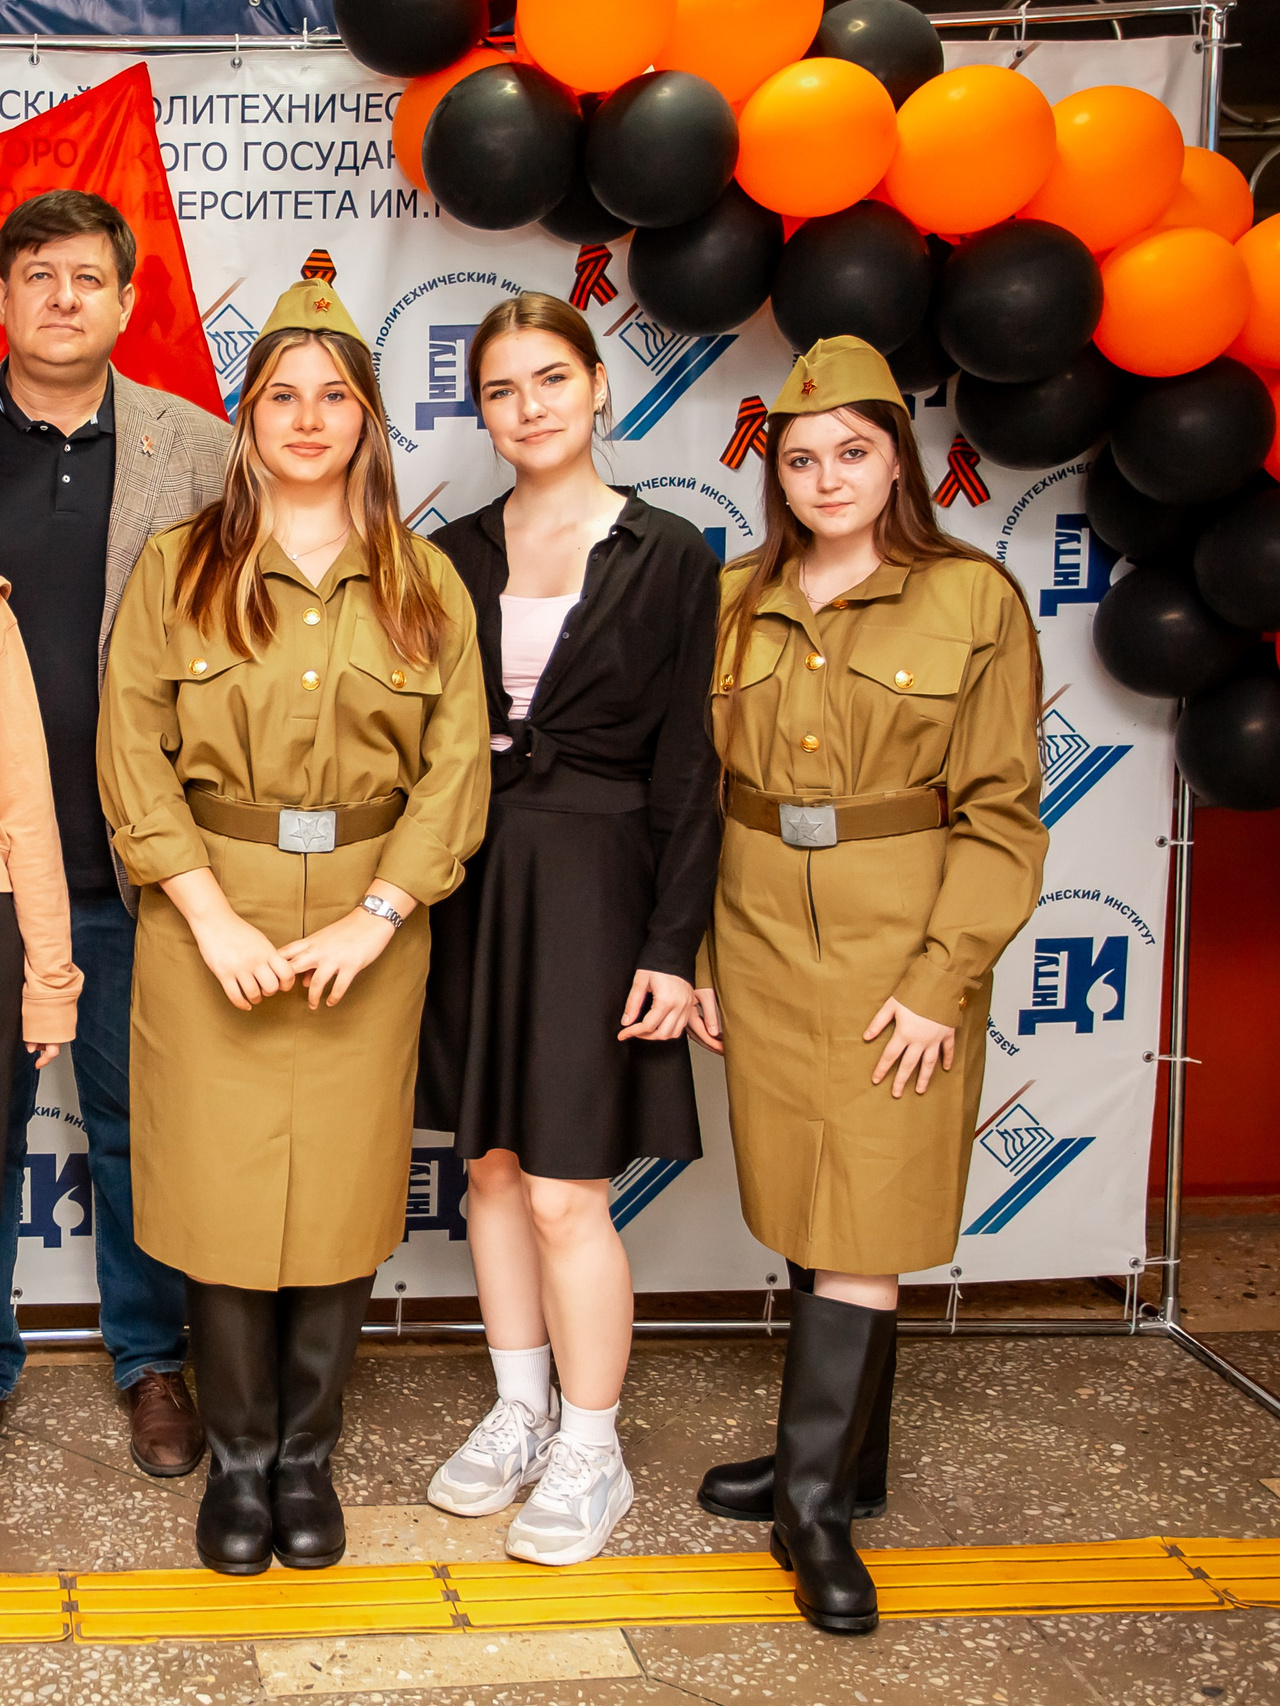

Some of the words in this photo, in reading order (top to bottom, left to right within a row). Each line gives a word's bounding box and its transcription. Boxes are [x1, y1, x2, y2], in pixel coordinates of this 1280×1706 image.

[375, 271, 497, 348] ПОЛИТЕХНИЧЕСКИЙ
[699, 483, 754, 538] ИНСТИТУТ
[1104, 895, 1156, 946] ИНСТИТУТ
